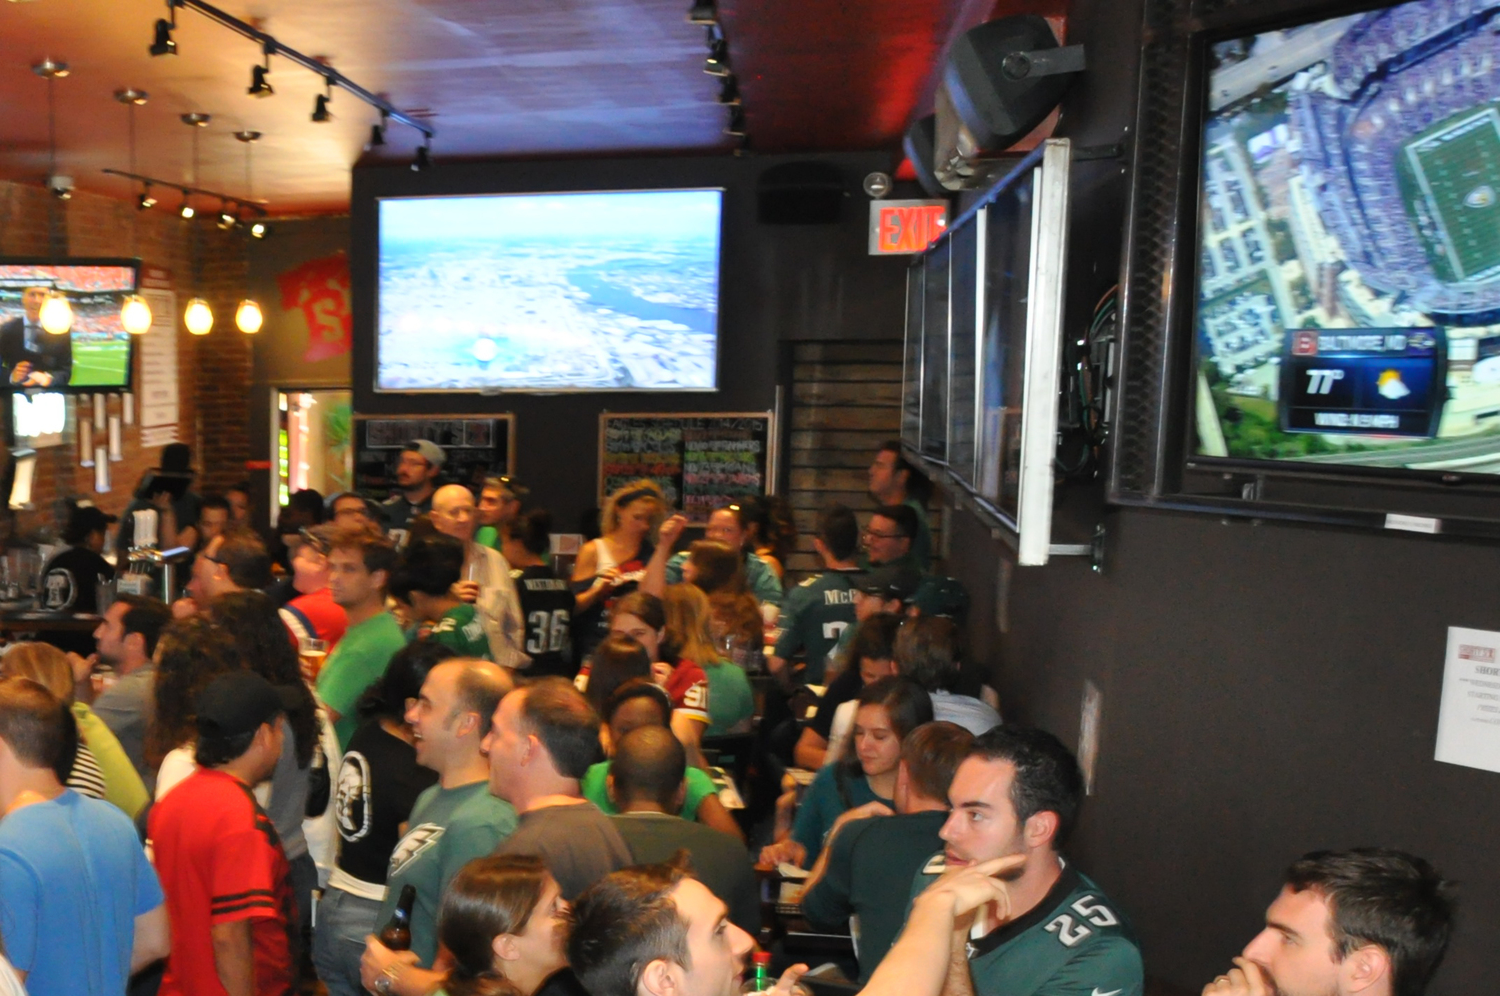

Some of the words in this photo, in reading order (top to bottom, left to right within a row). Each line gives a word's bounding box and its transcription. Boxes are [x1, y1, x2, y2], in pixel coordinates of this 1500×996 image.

[878, 206, 946, 252] EXIT
[526, 608, 570, 654] 36
[1043, 894, 1120, 947] 25
